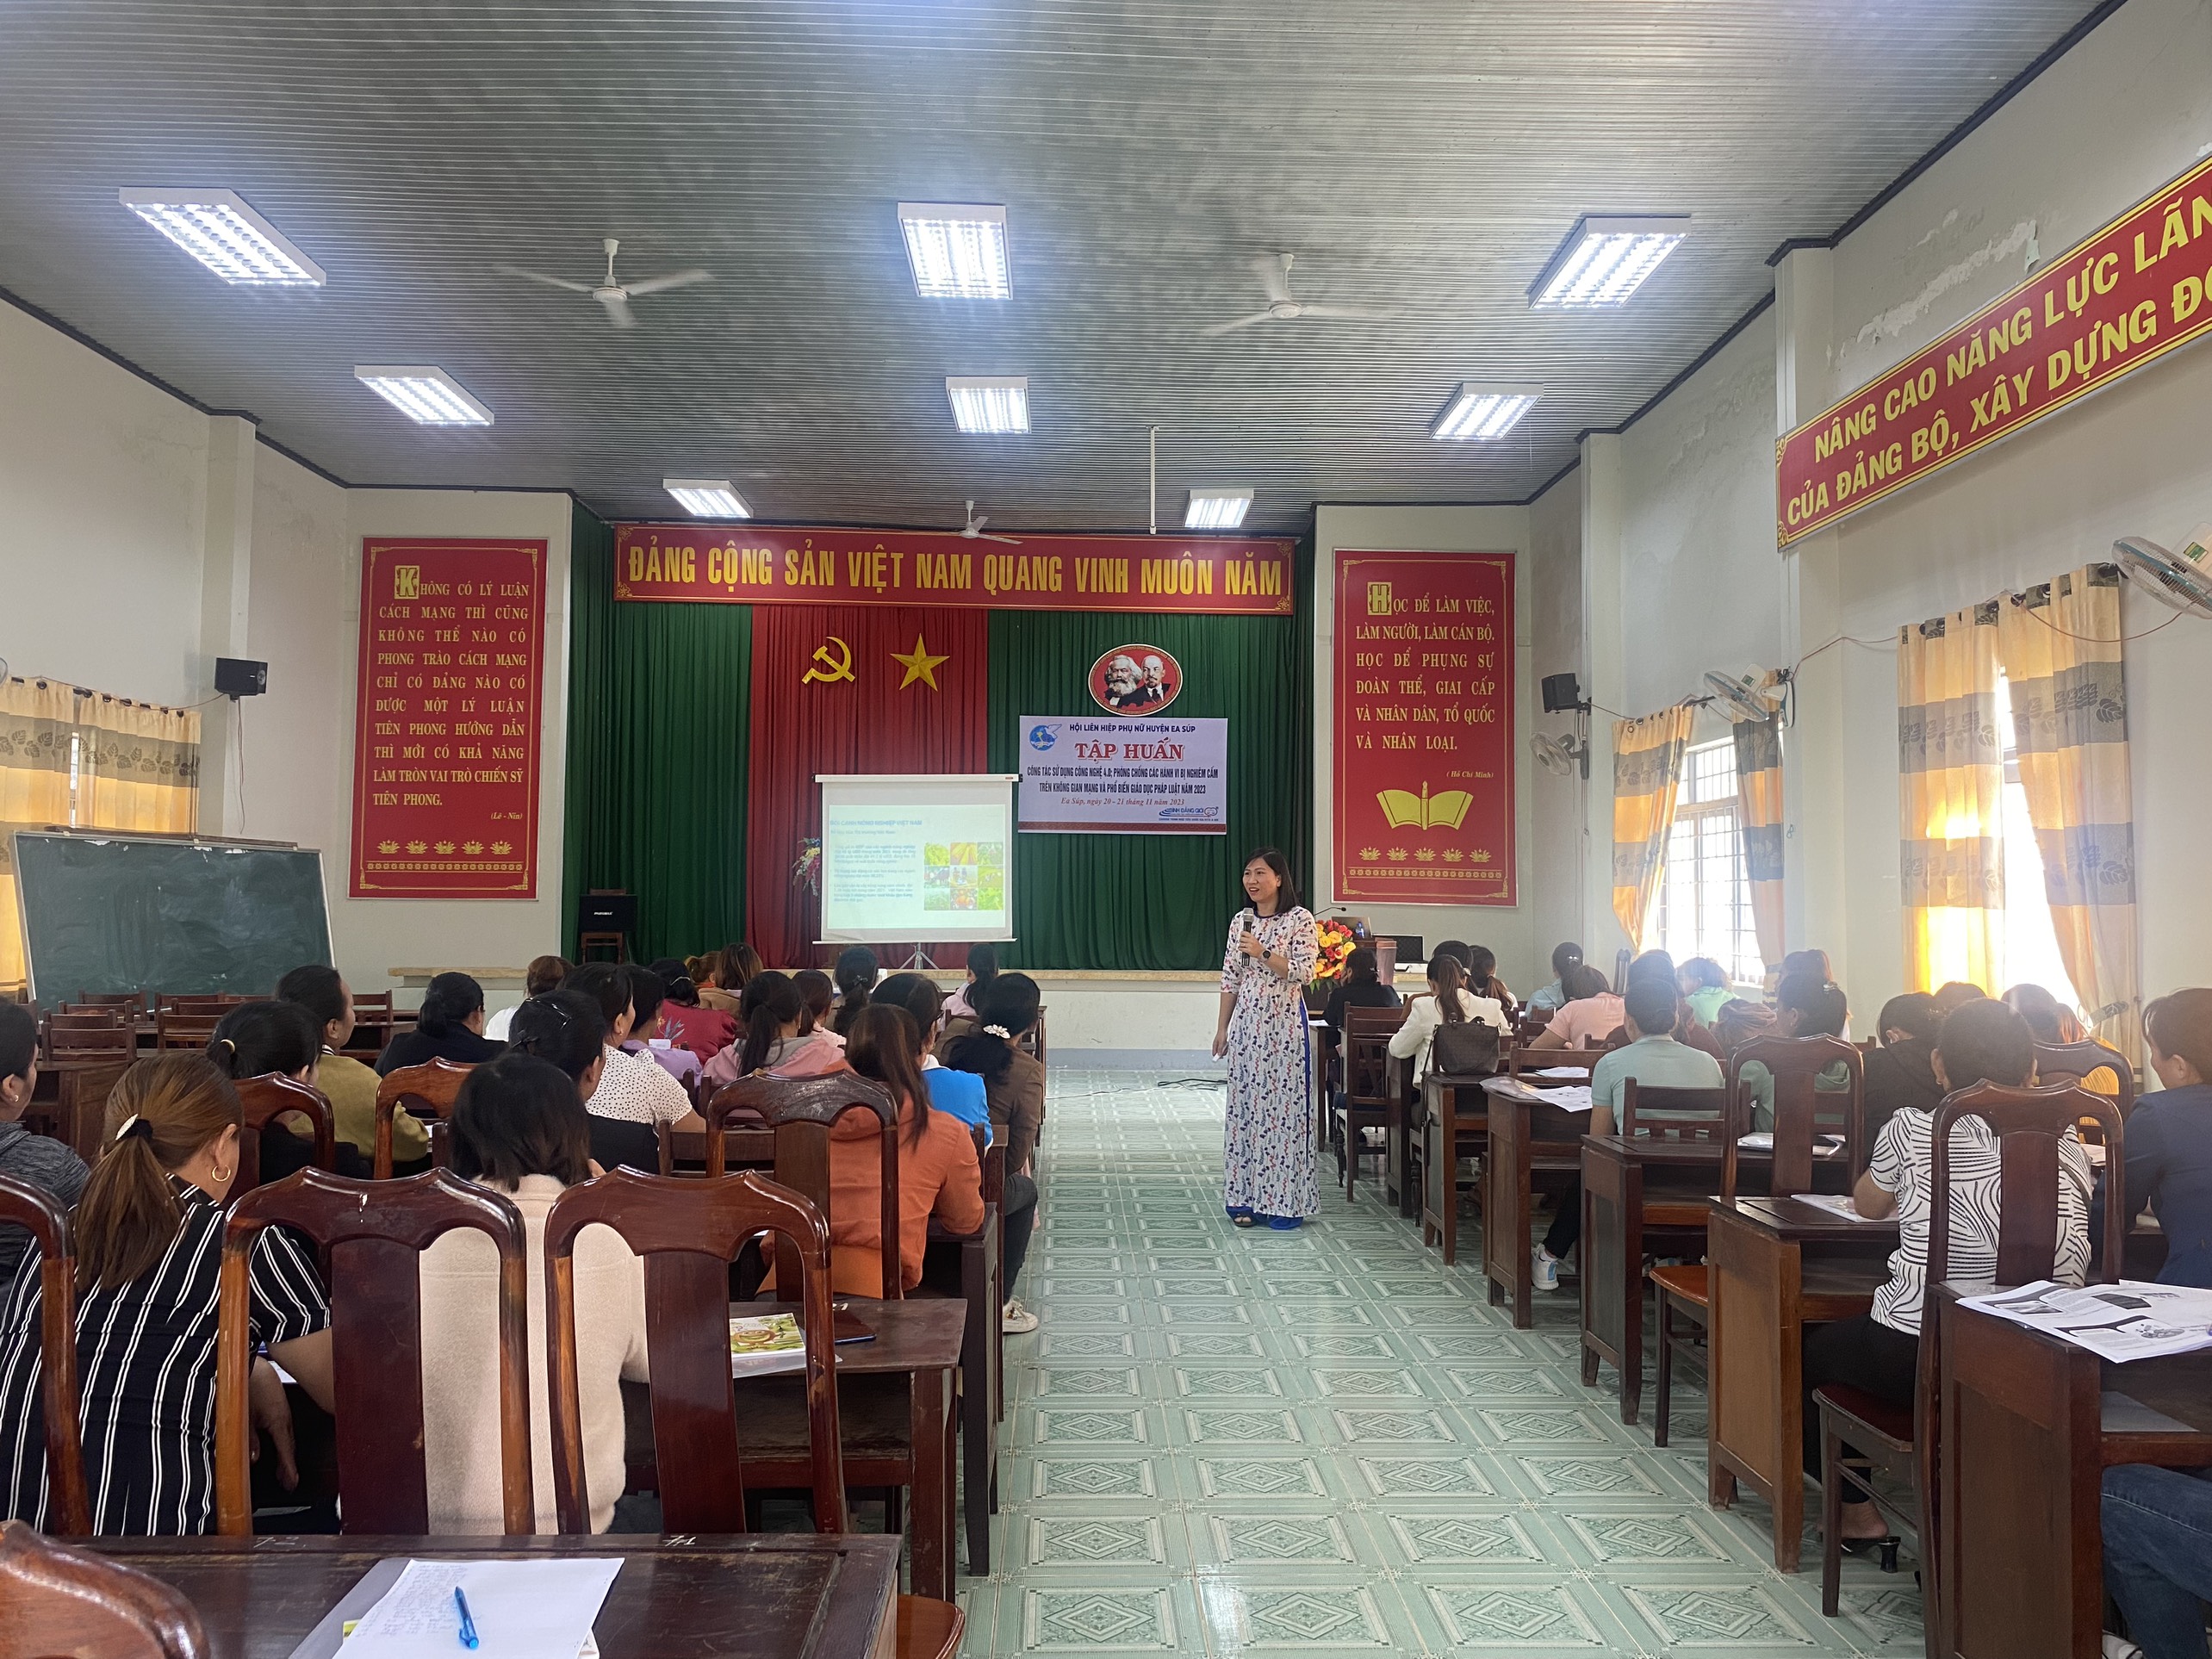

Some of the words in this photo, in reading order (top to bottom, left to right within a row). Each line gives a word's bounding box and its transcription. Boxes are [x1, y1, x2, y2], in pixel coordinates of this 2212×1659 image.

[1814, 404, 1876, 463] NÂNG
[1884, 367, 1936, 421] CAO
[1946, 308, 2032, 387] NĂNG
[2044, 252, 2119, 329] LỰC
[1787, 480, 1830, 525] CỦA
[1836, 442, 1902, 501] ĐẢNG
[1911, 409, 1959, 463] BỘ,
[1969, 366, 2034, 432] XÂY
[2047, 300, 2157, 391] DỰNG
[2172, 264, 2212, 324] Đ
[628, 536, 696, 582] ĐẢNG
[707, 540, 773, 593] CỘNG
[785, 539, 835, 586] SẢN
[848, 544, 904, 593] VIỆT
[916, 553, 971, 589] NAM
[984, 554, 1062, 595] QUANG
[1075, 557, 1128, 593] VINH
[1140, 550, 1213, 595] MUÔN
[1225, 551, 1281, 596] NĂM
[457, 581, 472, 596] CÓ
[479, 581, 494, 596] LÝ
[500, 581, 529, 599] LUẬN
[379, 603, 410, 618] CÁCH
[421, 606, 456, 620] MẠNG
[465, 604, 486, 618] THÌ
[494, 605, 529, 619] CŨNG
[1414, 593, 1430, 612] ĐỂ
[1436, 595, 1459, 612] LÀM
[1465, 596, 1494, 616] VIỆC,
[378, 627, 425, 642] KHÔNG
[435, 624, 460, 642] THỂ
[471, 627, 497, 643] NÀO
[509, 628, 526, 643] CÓ
[1356, 622, 1380, 639] LÀM
[1382, 622, 1421, 642] NGƯỜI,
[1425, 622, 1448, 640] LÀM
[1451, 623, 1474, 640] CÁN
[1476, 624, 1494, 643] BỘ.
[377, 653, 414, 665] PHONG
[423, 649, 450, 665] TRÀO
[458, 650, 488, 665] CÁCH
[495, 654, 526, 668] MẠNG
[1356, 653, 1383, 670] HỌC
[1394, 647, 1411, 667] ĐỂ
[1422, 654, 1468, 670] PHỤNG
[1477, 652, 1494, 671] SỰ
[376, 671, 398, 687] CHỈ
[407, 673, 422, 688] CÓ
[432, 671, 466, 688] ĐẢNG
[475, 674, 500, 688] NÀO
[509, 674, 525, 689] CÓ
[1356, 676, 1389, 694] ĐOÀN
[1399, 674, 1426, 697] THỂ,
[1436, 681, 1462, 695] GIAI
[1471, 675, 1494, 695] CẤP
[376, 698, 407, 714] ĐƯỢC
[424, 697, 448, 714] MỘT
[462, 697, 475, 711] LÝ
[490, 697, 525, 715] LUẬN
[1356, 704, 1371, 721] VÀ
[1376, 704, 1407, 721] NHÂN
[1413, 704, 1439, 724] DÂN,
[1444, 701, 1459, 722] TỔ
[1464, 703, 1494, 725] QUỐC
[375, 720, 401, 735] TIÊN
[409, 724, 446, 735] PHONG
[455, 720, 494, 736] HƯỚNG
[502, 718, 525, 736] DẪN
[1069, 723, 1082, 733] HỘI
[1084, 723, 1099, 731] LIÊN
[1101, 723, 1116, 733] HIỆP
[1118, 724, 1133, 733] PHỤ
[1134, 724, 1145, 732] NỮ
[1146, 724, 1169, 734] HUYỆN
[1182, 724, 1196, 733] SÚP
[1074, 739, 1117, 761] TẬP
[1123, 736, 1184, 760] HUẤN
[1356, 731, 1372, 749] VÀ
[1382, 731, 1416, 749] NHÂN
[1426, 736, 1457, 752] LOẠI.
[374, 743, 394, 758] THÌ
[402, 743, 425, 758] MỚI
[434, 743, 450, 759] CÓ
[458, 743, 482, 759] KHẢ
[492, 745, 524, 760] NĂNG
[373, 767, 395, 782] LÀM
[399, 767, 426, 782] TRÒN
[430, 771, 448, 782] VAI
[450, 767, 472, 782] TRÒ
[475, 766, 507, 782] CHIẾN
[510, 767, 524, 783] SỸ
[373, 791, 398, 805] TIÊN
[403, 794, 443, 805] PHONG.
